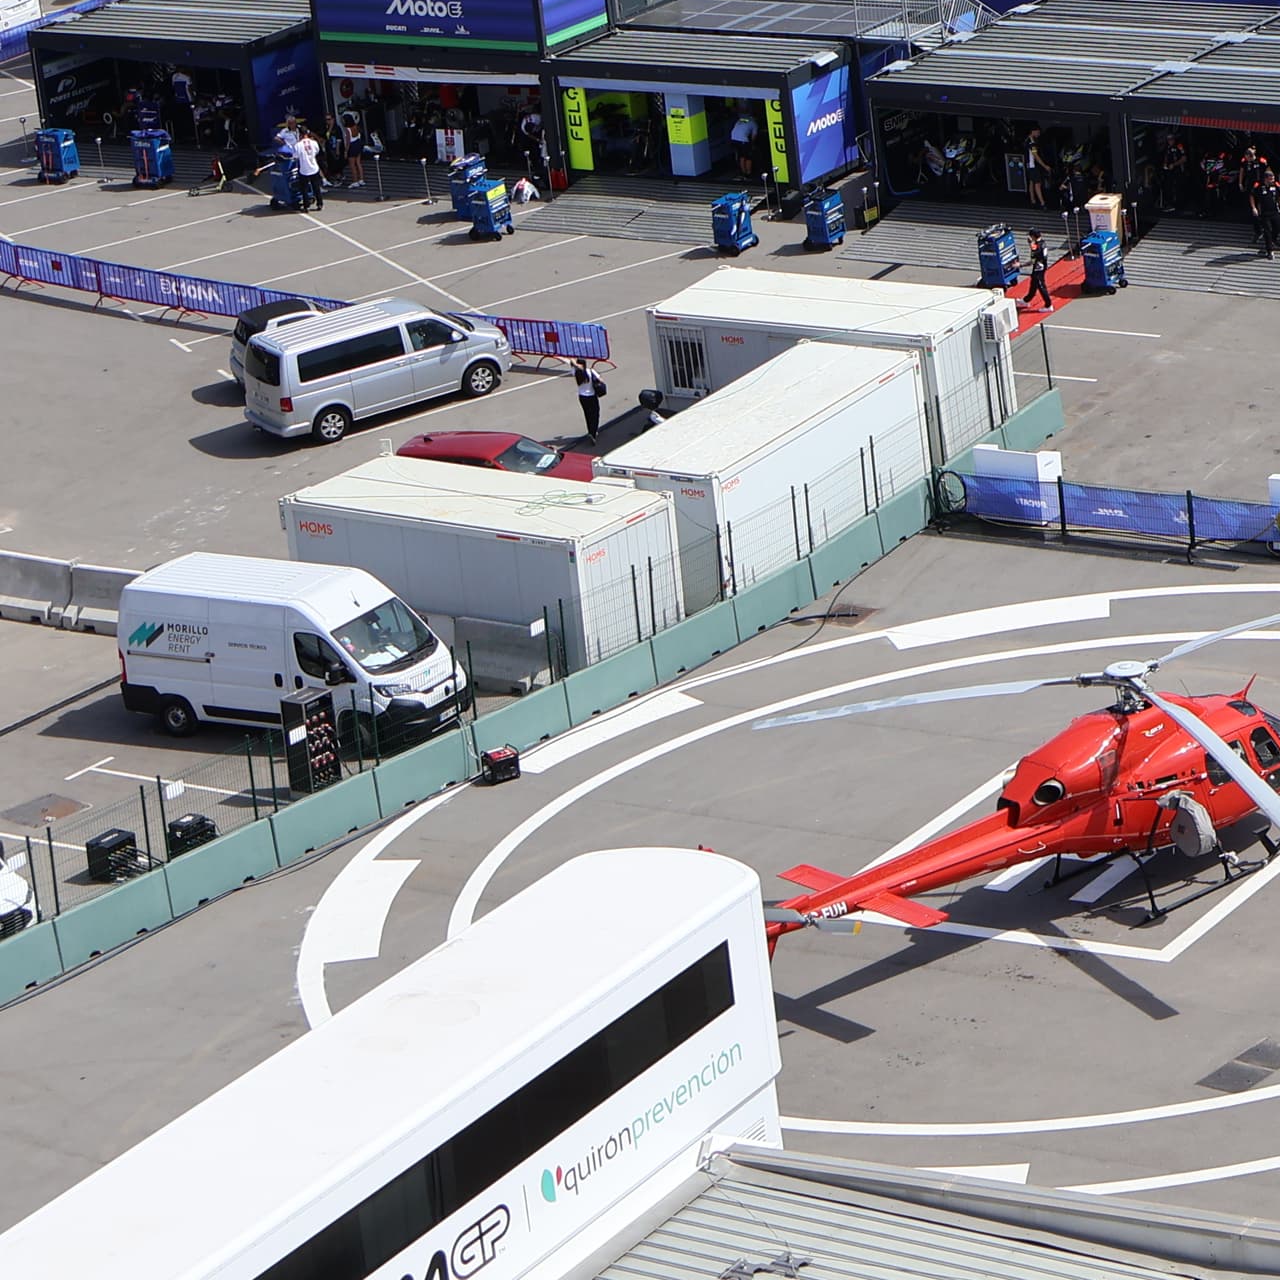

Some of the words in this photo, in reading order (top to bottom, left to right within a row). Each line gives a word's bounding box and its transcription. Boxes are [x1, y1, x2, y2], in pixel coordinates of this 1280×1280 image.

[385, 24, 407, 32] DUCATI
[721, 336, 745, 345] HOMS
[681, 488, 705, 499] HOMS
[299, 520, 334, 536] HOMS
[167, 623, 209, 636] MORILLO
[168, 633, 202, 645] ENERGY
[168, 643, 191, 654] RENT
